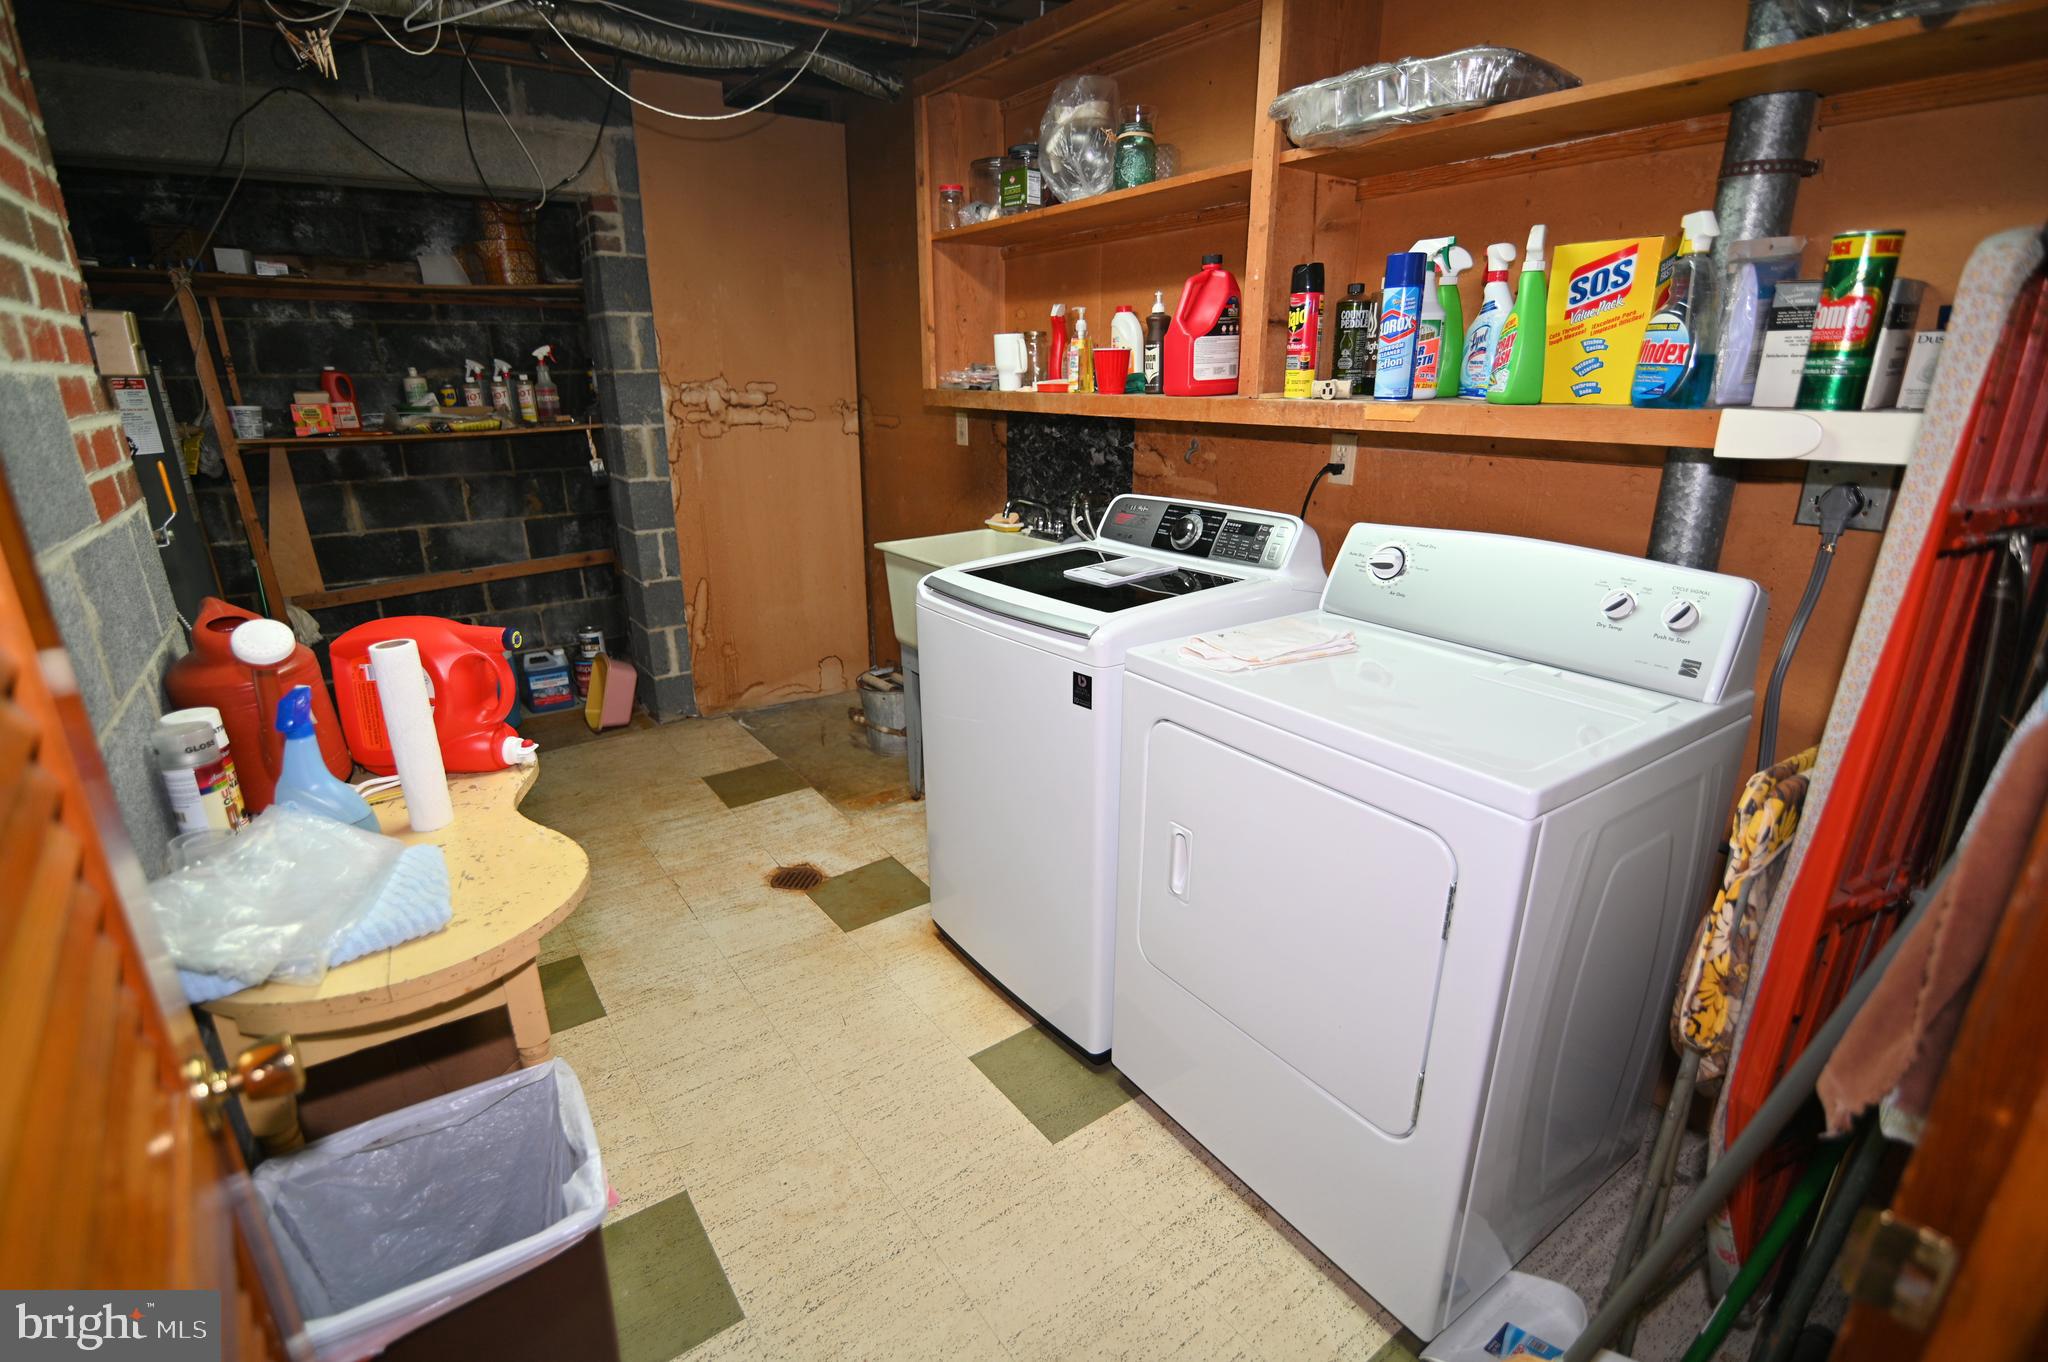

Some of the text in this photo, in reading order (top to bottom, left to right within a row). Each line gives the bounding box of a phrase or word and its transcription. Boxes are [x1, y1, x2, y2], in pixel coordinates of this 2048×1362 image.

[1569, 258, 1633, 305] S.O.S
[1570, 294, 1624, 325] Value Pack
[1620, 310, 1637, 320] Para
[1288, 307, 1307, 328] aid
[1340, 319, 1369, 329] PEDDLE
[1380, 315, 1414, 336] LOROX
[1549, 323, 1585, 340] Cuts Through
[1564, 329, 1587, 341] Messes!
[1596, 621, 1623, 631] Dry Temp
[1653, 633, 1667, 641] Push
[1675, 637, 1691, 645] Start
